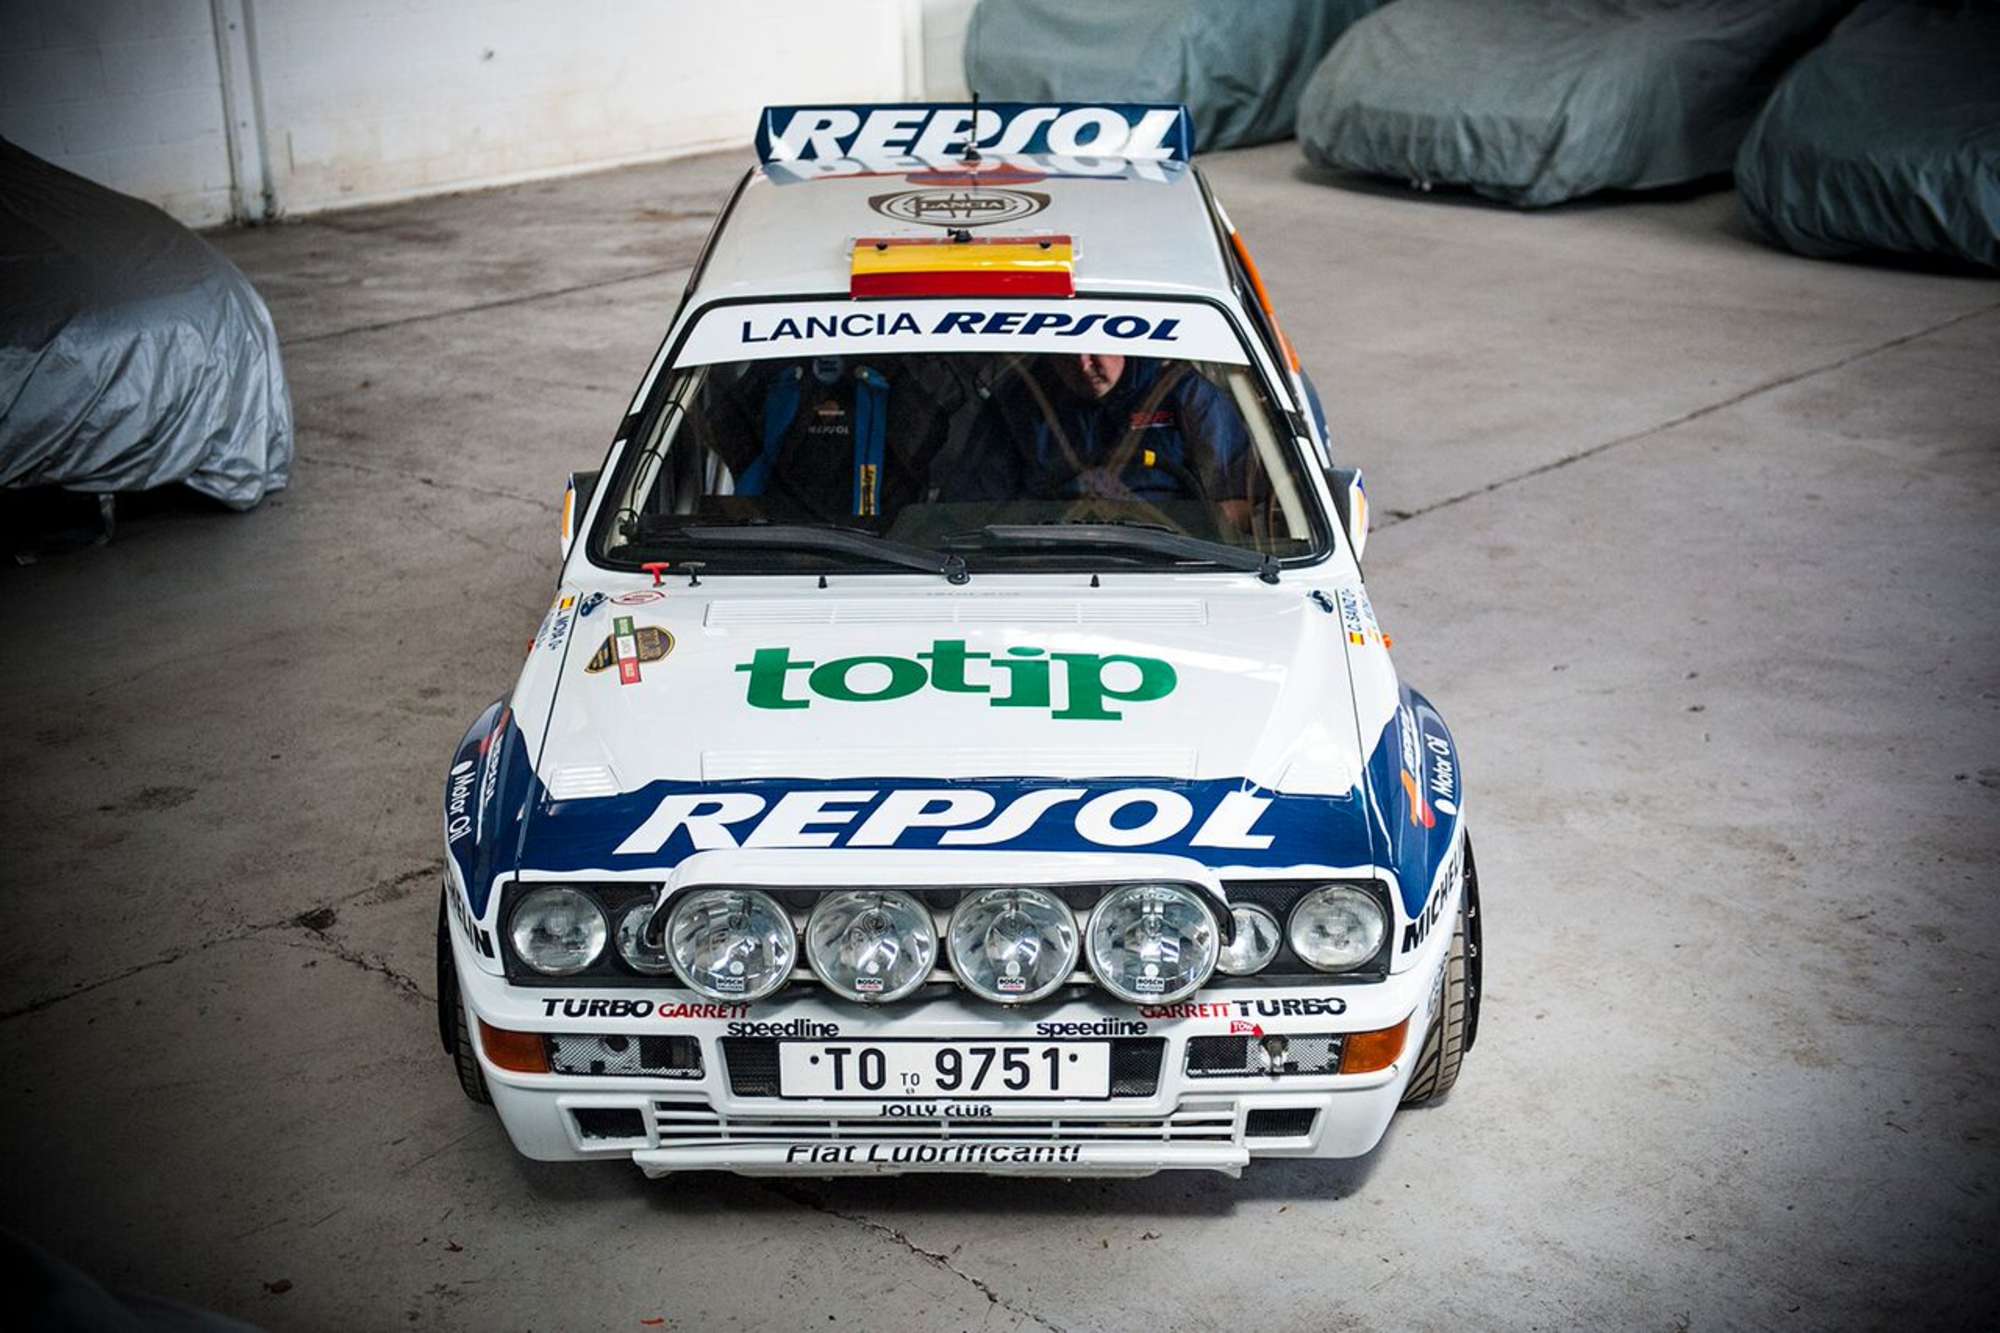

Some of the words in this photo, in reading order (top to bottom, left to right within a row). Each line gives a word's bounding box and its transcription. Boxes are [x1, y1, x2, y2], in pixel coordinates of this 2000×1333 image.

[769, 107, 1180, 161] REPSOL
[920, 200, 1001, 210] LANCIA
[741, 311, 922, 343] LANCIA
[930, 311, 1183, 342] REPSOL
[735, 639, 1179, 720] totip
[1431, 755, 1454, 799] Motor
[450, 771, 477, 816] Motor
[448, 816, 473, 844] Oil
[612, 788, 1275, 855] REPSOL
[542, 998, 655, 1018] TURBO
[658, 1001, 752, 1019] GARRETT
[1138, 1002, 1231, 1019] GARRETT
[1232, 997, 1348, 1017] TURBO
[727, 1018, 840, 1037] speedline
[1036, 1017, 1149, 1037] speedline
[824, 1047, 887, 1091] TO
[935, 1047, 1061, 1091] 9751
[879, 1104, 938, 1118] JOLLY
[944, 1104, 993, 1118] CLUB
[786, 1143, 857, 1163] Fiat
[866, 1142, 1083, 1163] Lubrificanti
